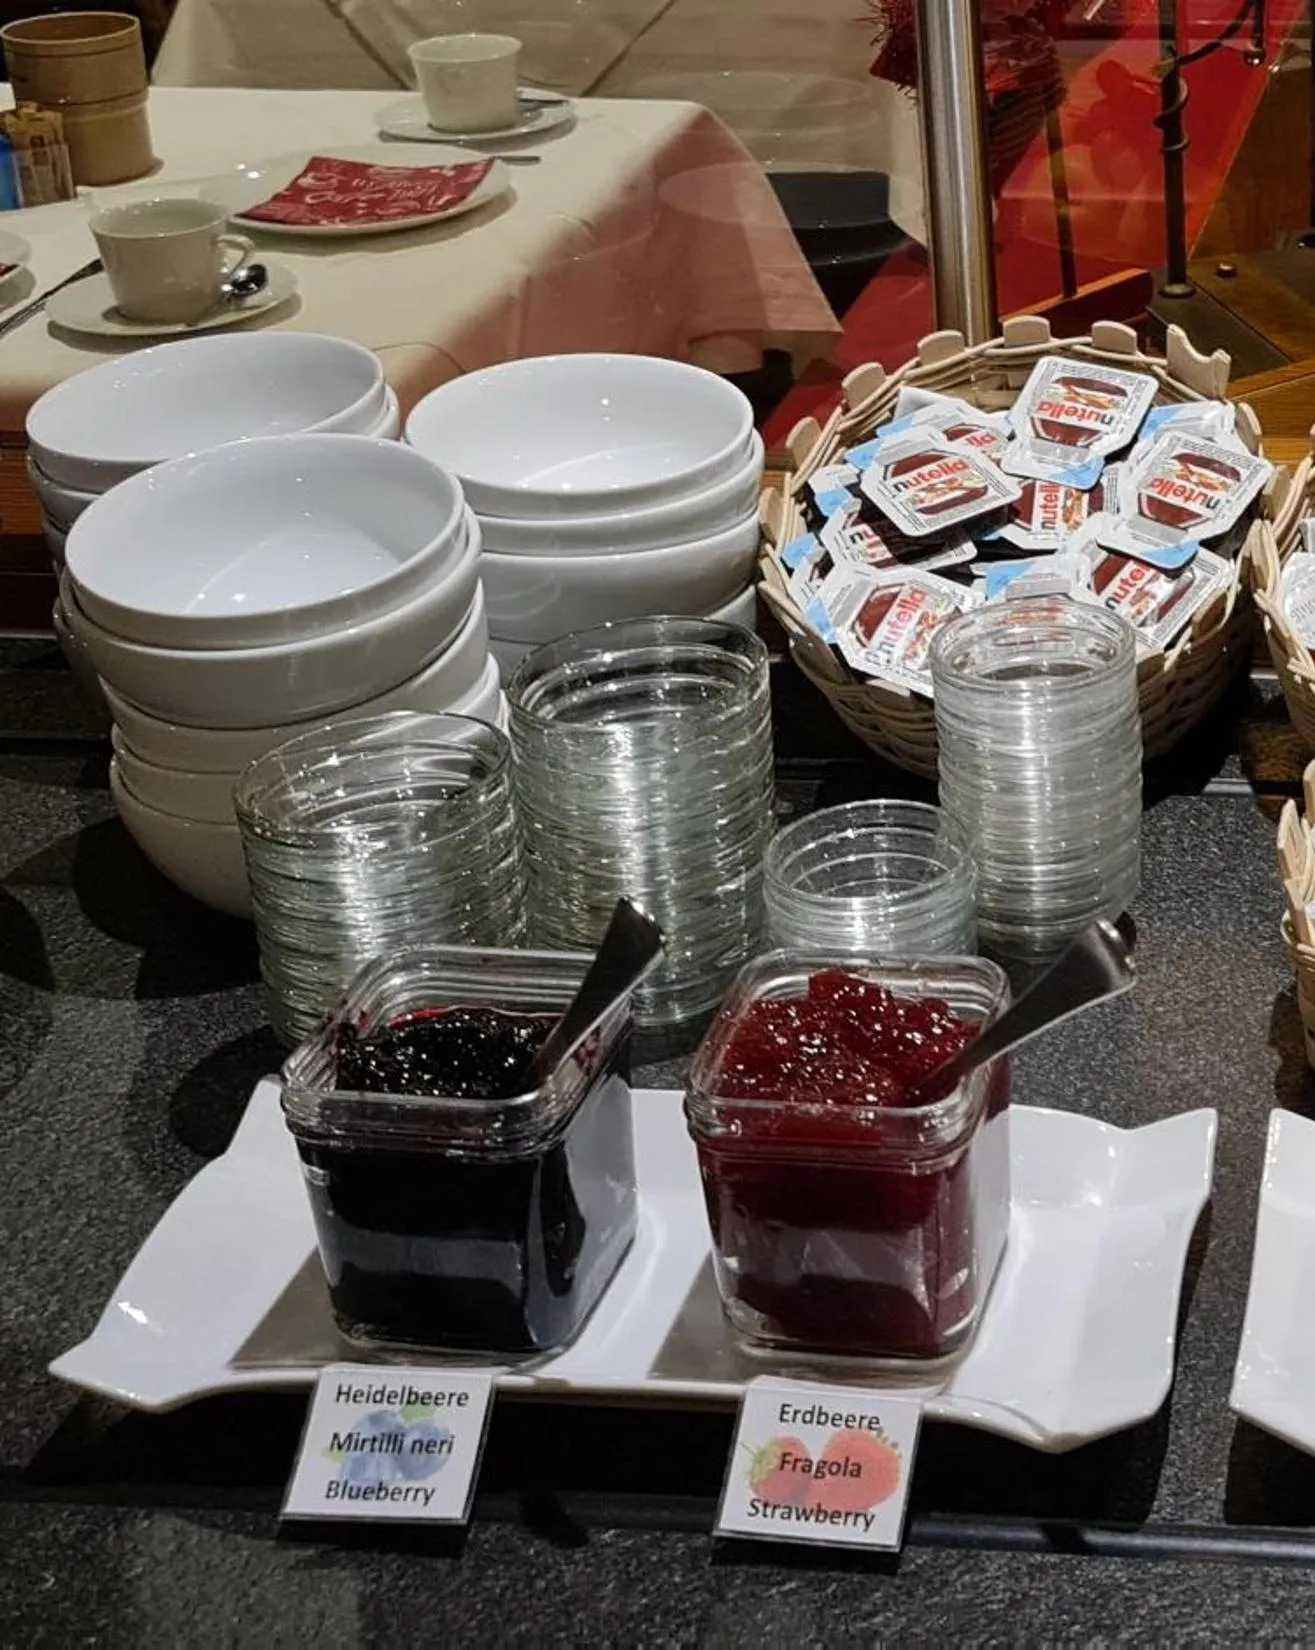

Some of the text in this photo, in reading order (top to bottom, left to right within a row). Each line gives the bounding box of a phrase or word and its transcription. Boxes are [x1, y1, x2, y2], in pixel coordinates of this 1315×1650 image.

[1036, 400, 1116, 426] nutella
[893, 459, 969, 493] nutella
[1039, 483, 1060, 530] nutell
[1150, 476, 1222, 509] nutella
[876, 588, 927, 652] nutella
[335, 1384, 470, 1407] Heidelbeere
[779, 1403, 881, 1431] Erdbeere
[329, 1432, 455, 1456] Mirtilli neri
[779, 1452, 862, 1479] Fragola
[325, 1480, 436, 1506] Blueberry
[747, 1498, 876, 1532] Strawberry
